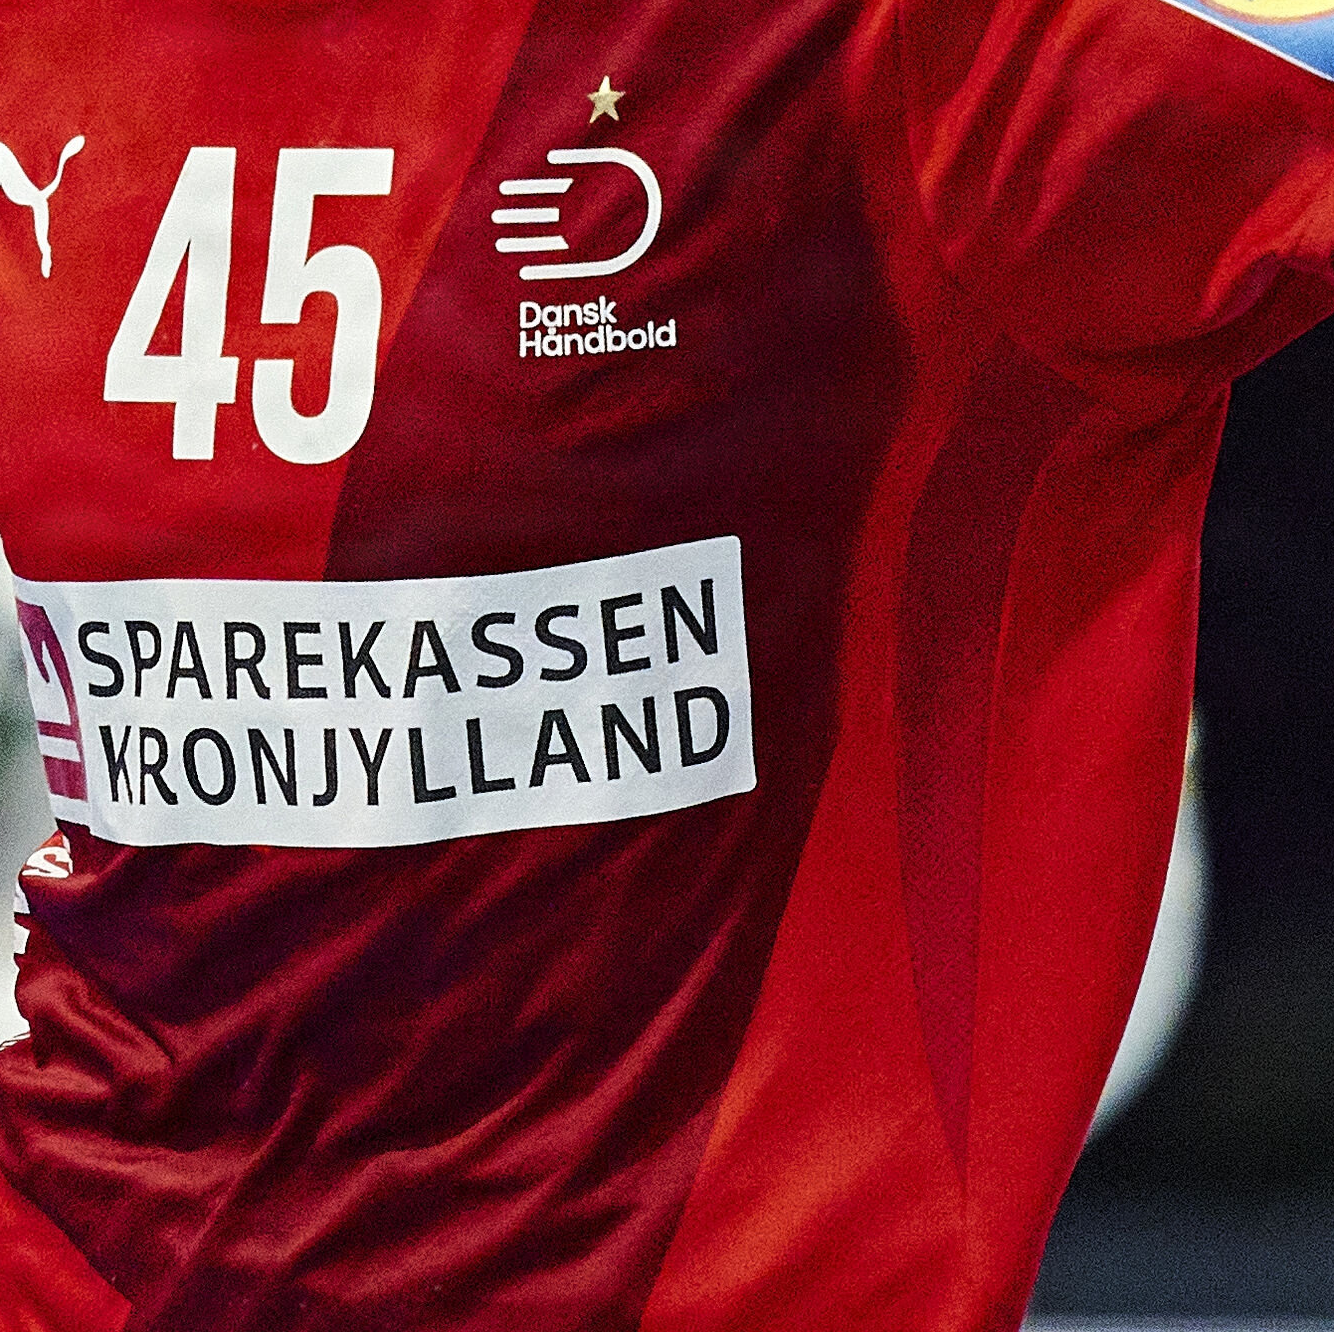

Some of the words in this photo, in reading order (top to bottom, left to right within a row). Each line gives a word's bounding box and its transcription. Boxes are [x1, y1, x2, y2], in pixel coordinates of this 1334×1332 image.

[103, 146, 395, 465] 45
[519, 295, 618, 329] Dansk
[519, 318, 677, 358] Håndbold
[78, 577, 720, 701] SPAREKASSEN
[98, 685, 731, 808] KRONJYLLAND
